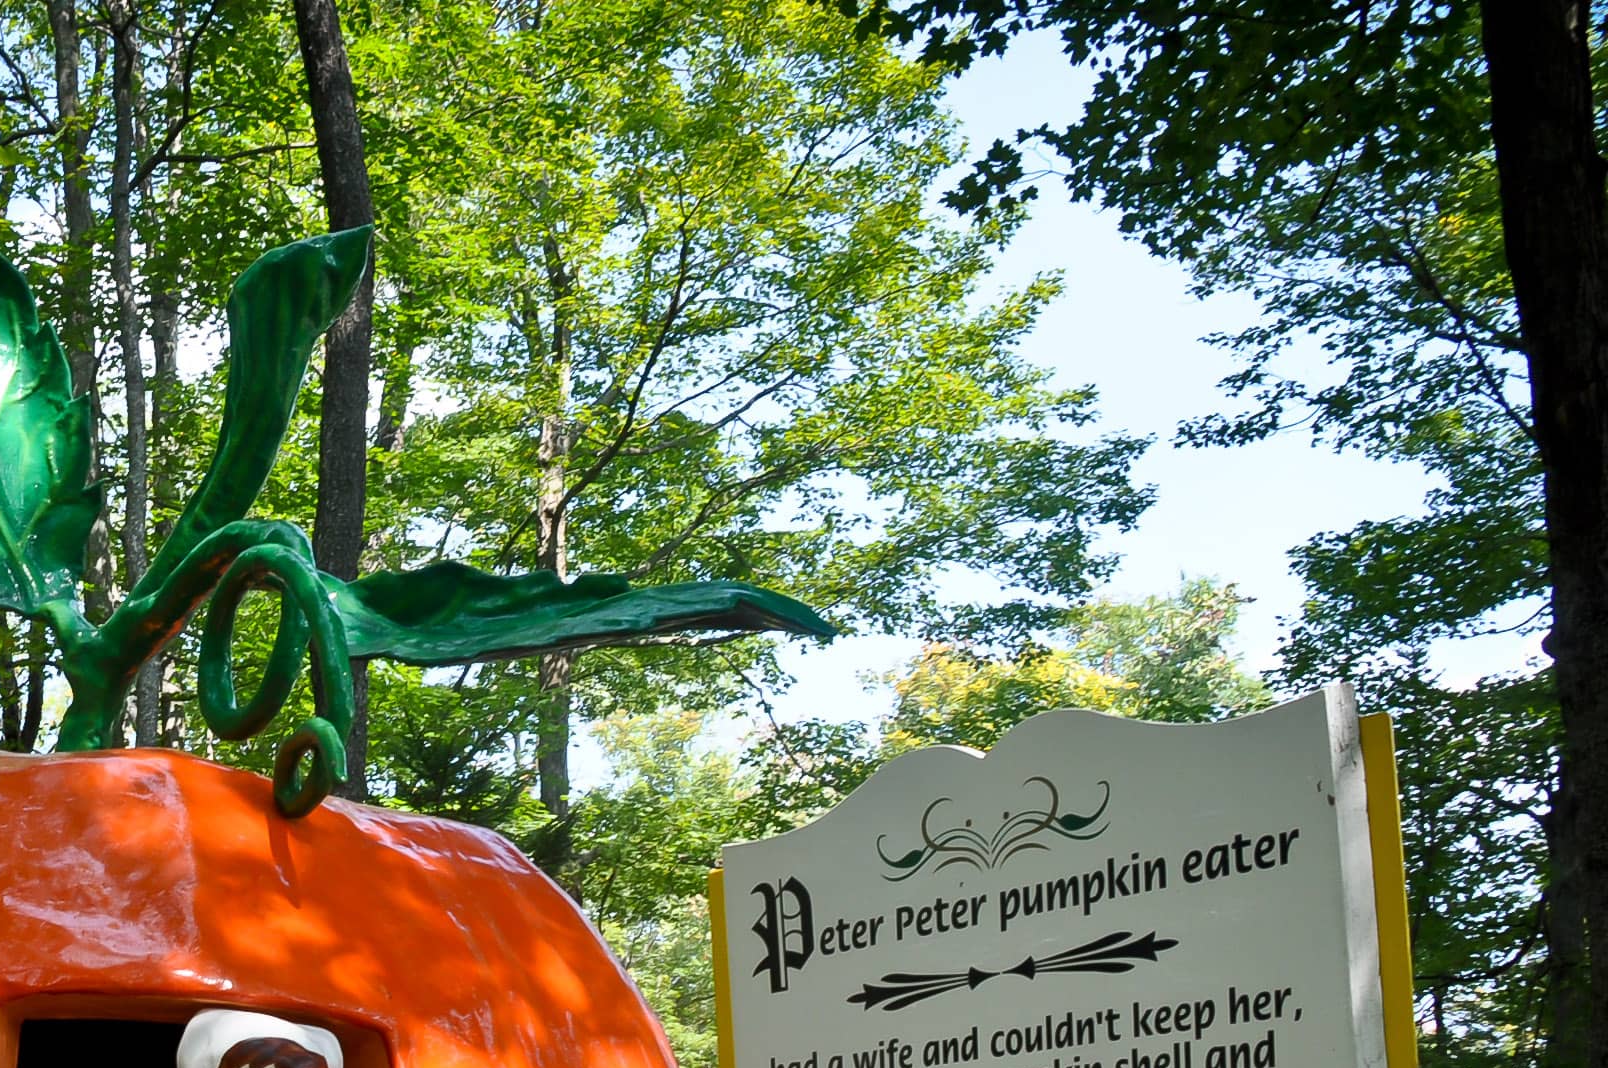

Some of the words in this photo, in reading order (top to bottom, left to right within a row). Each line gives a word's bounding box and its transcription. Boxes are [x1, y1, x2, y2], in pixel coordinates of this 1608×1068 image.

[750, 875, 885, 994] Peter
[895, 893, 988, 942] Peter
[999, 852, 1168, 933] pumpkin
[1182, 828, 1301, 884] eater
[922, 1026, 979, 1068] and
[990, 1008, 1122, 1059] couldn't
[1131, 1000, 1216, 1042] keep
[1228, 986, 1303, 1026] her,
